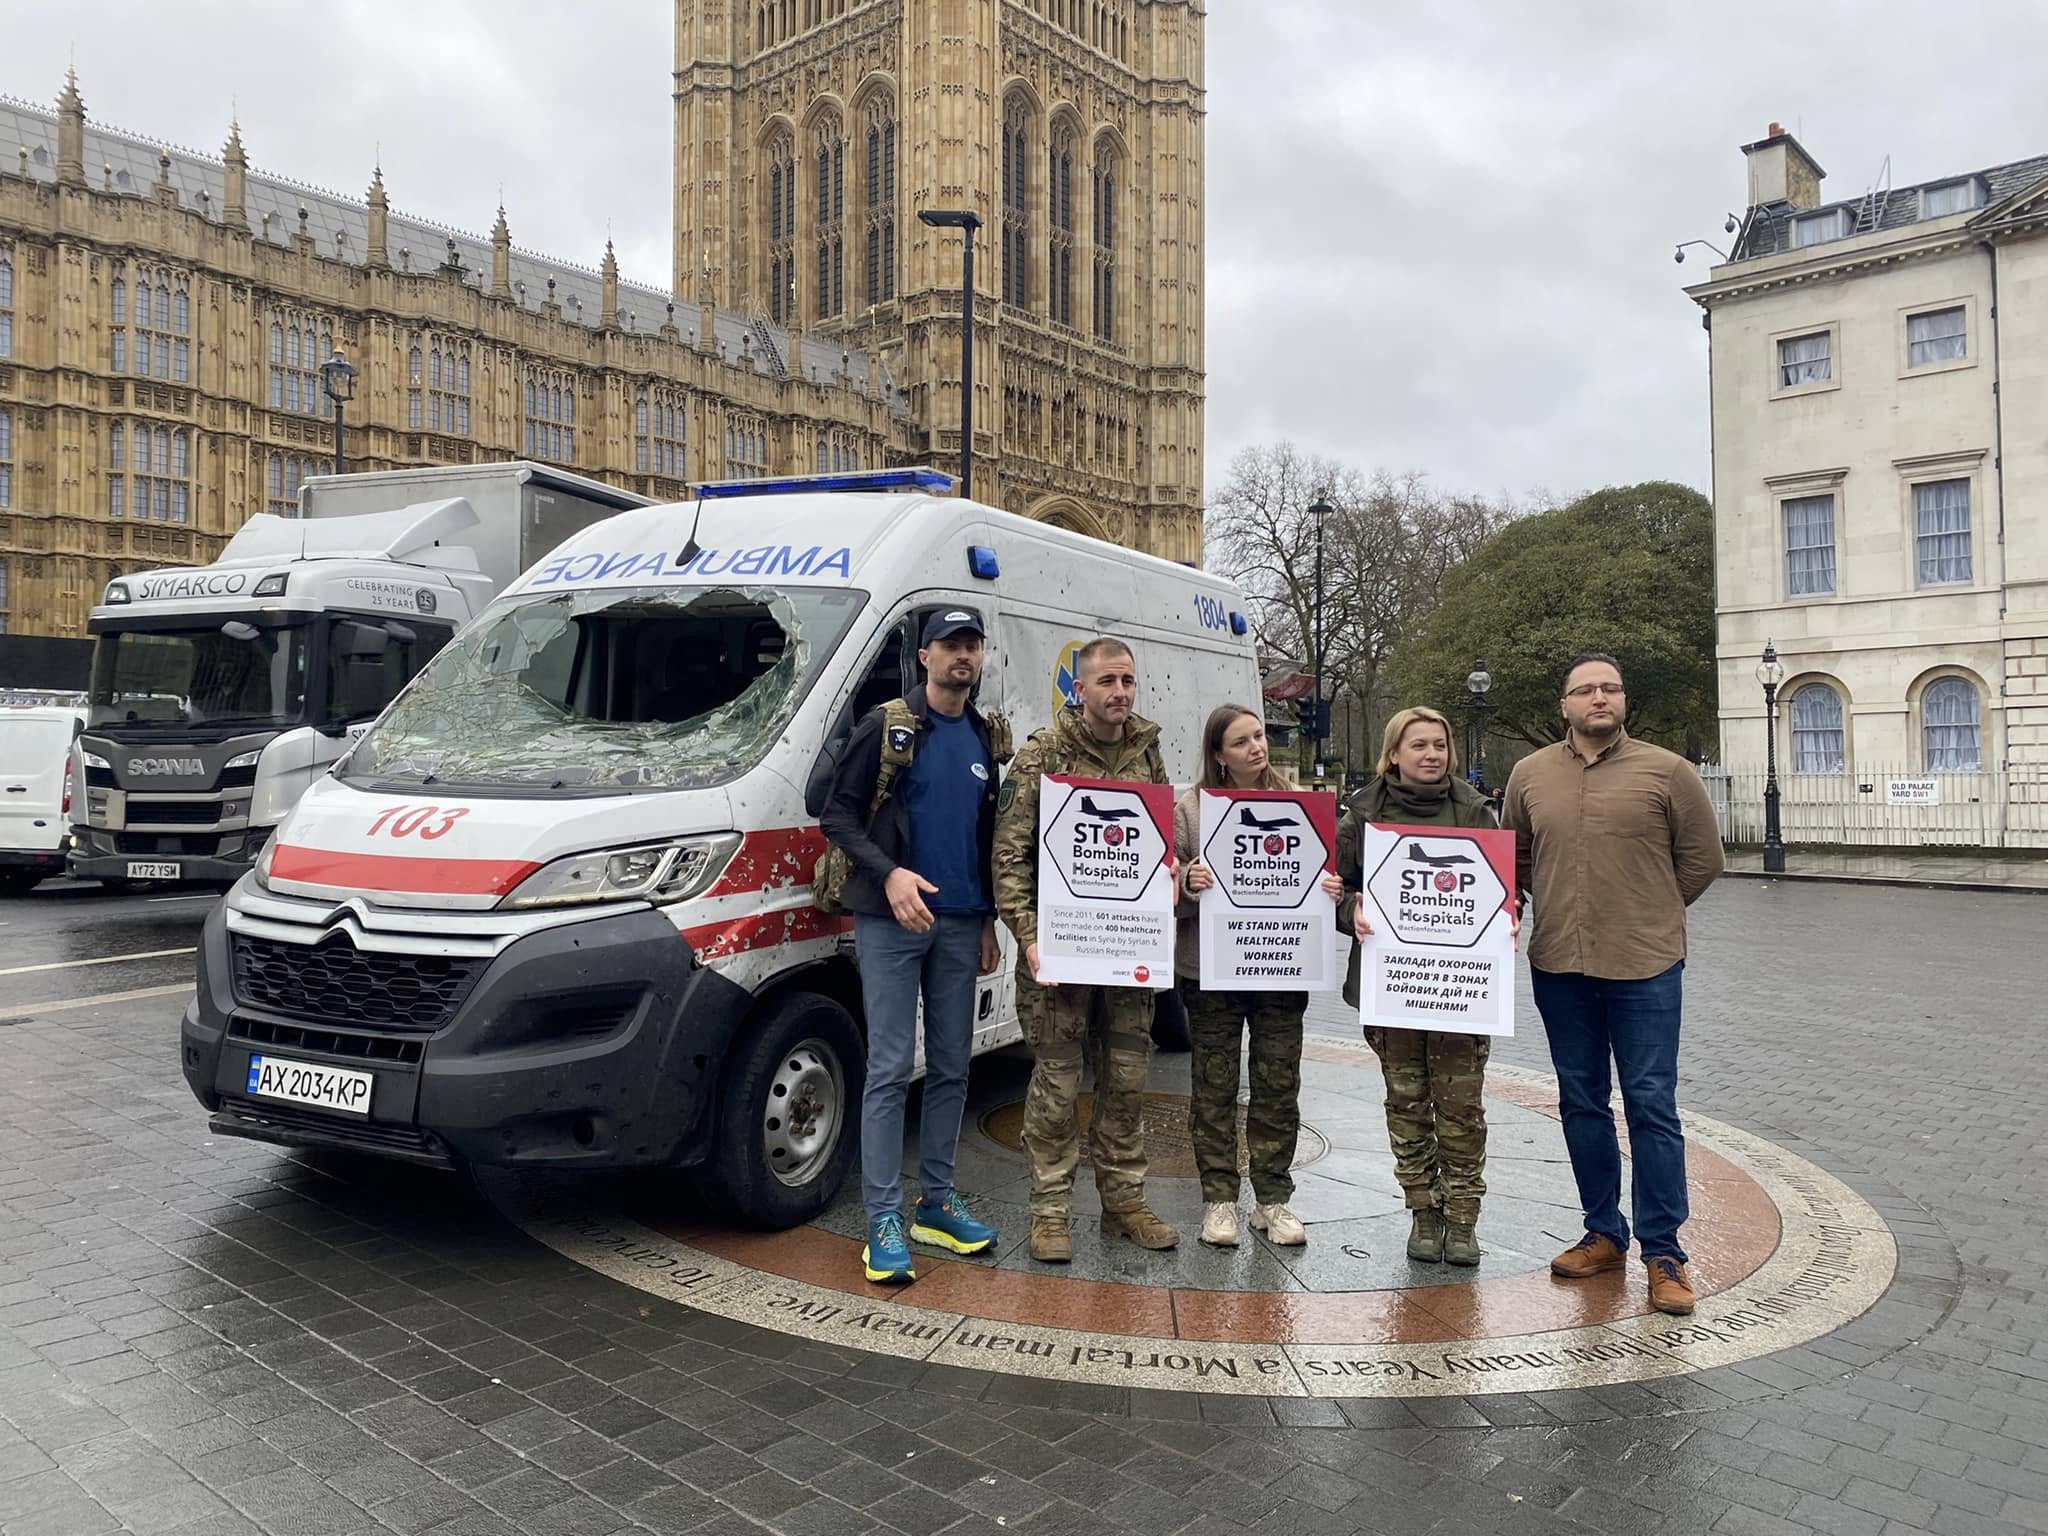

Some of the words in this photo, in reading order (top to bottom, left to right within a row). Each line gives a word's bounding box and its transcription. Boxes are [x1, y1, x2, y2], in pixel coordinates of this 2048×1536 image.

[140, 574, 246, 598] SIMARCO
[347, 580, 413, 596] CELEBRATING
[372, 595, 382, 605] 25
[386, 598, 414, 609] YEARS
[1194, 593, 1227, 632] 1804
[127, 758, 205, 776] SCANIA
[367, 805, 470, 840] 103
[1074, 823, 1140, 846] STOP
[1234, 834, 1300, 856] STOP
[1073, 845, 1140, 866] Bombing
[1233, 856, 1300, 873] Bombing
[132, 864, 155, 877] AY72
[158, 865, 176, 877] YSM
[1072, 862, 1139, 881] Hospitals
[1232, 873, 1300, 889] Hospitals
[1401, 869, 1476, 893] STOP
[1399, 891, 1475, 912] Bombing
[1054, 910, 1073, 918] Since
[1096, 912, 1109, 920] 601
[1111, 914, 1140, 922] attacks
[1141, 915, 1159, 923] have
[1399, 908, 1475, 927] Hospitals
[1051, 921, 1069, 929] been
[1071, 923, 1092, 931] made
[1120, 925, 1161, 935] healthcare
[1228, 921, 1243, 930] WE
[1245, 921, 1279, 930] STAND
[1282, 922, 1308, 931] WITH
[1054, 932, 1088, 942] facilities
[1098, 935, 1115, 945] Syria
[1118, 937, 1126, 945] by
[1128, 937, 1151, 946] Syrian
[1236, 936, 1300, 946] HEALTHCARE
[1075, 945, 1104, 955] Russian
[1106, 947, 1137, 957] Regimes
[1244, 951, 1293, 961] WORKERS
[1235, 966, 1302, 976] EVERYWHERE
[1384, 954, 1435, 968] ЗАКЛАДИ
[1438, 959, 1492, 972] ОХОРОНИ
[1442, 974, 1449, 982] В
[1452, 974, 1489, 985] ЗОНАХ
[1385, 983, 1438, 995] БОЙОВИХ
[1440, 986, 1462, 999] ДІЙ
[1465, 990, 1479, 999] НЕ
[1481, 991, 1489, 999] Є
[1405, 999, 1468, 1012] МІШЕНЯМИ
[596, 1236, 678, 1269] carve
[671, 1266, 715, 1288] To
[1779, 1269, 1852, 1301] finish
[766, 1293, 844, 1323] live
[1746, 1298, 1802, 1315] up
[843, 1311, 942, 1340] may
[1712, 1310, 1782, 1332] the
[955, 1331, 1056, 1357] man
[1069, 1346, 1241, 1378] Mortal
[1252, 1358, 1282, 1375] a
[1305, 1360, 1445, 1381] Years
[1441, 1351, 1563, 1374] many
